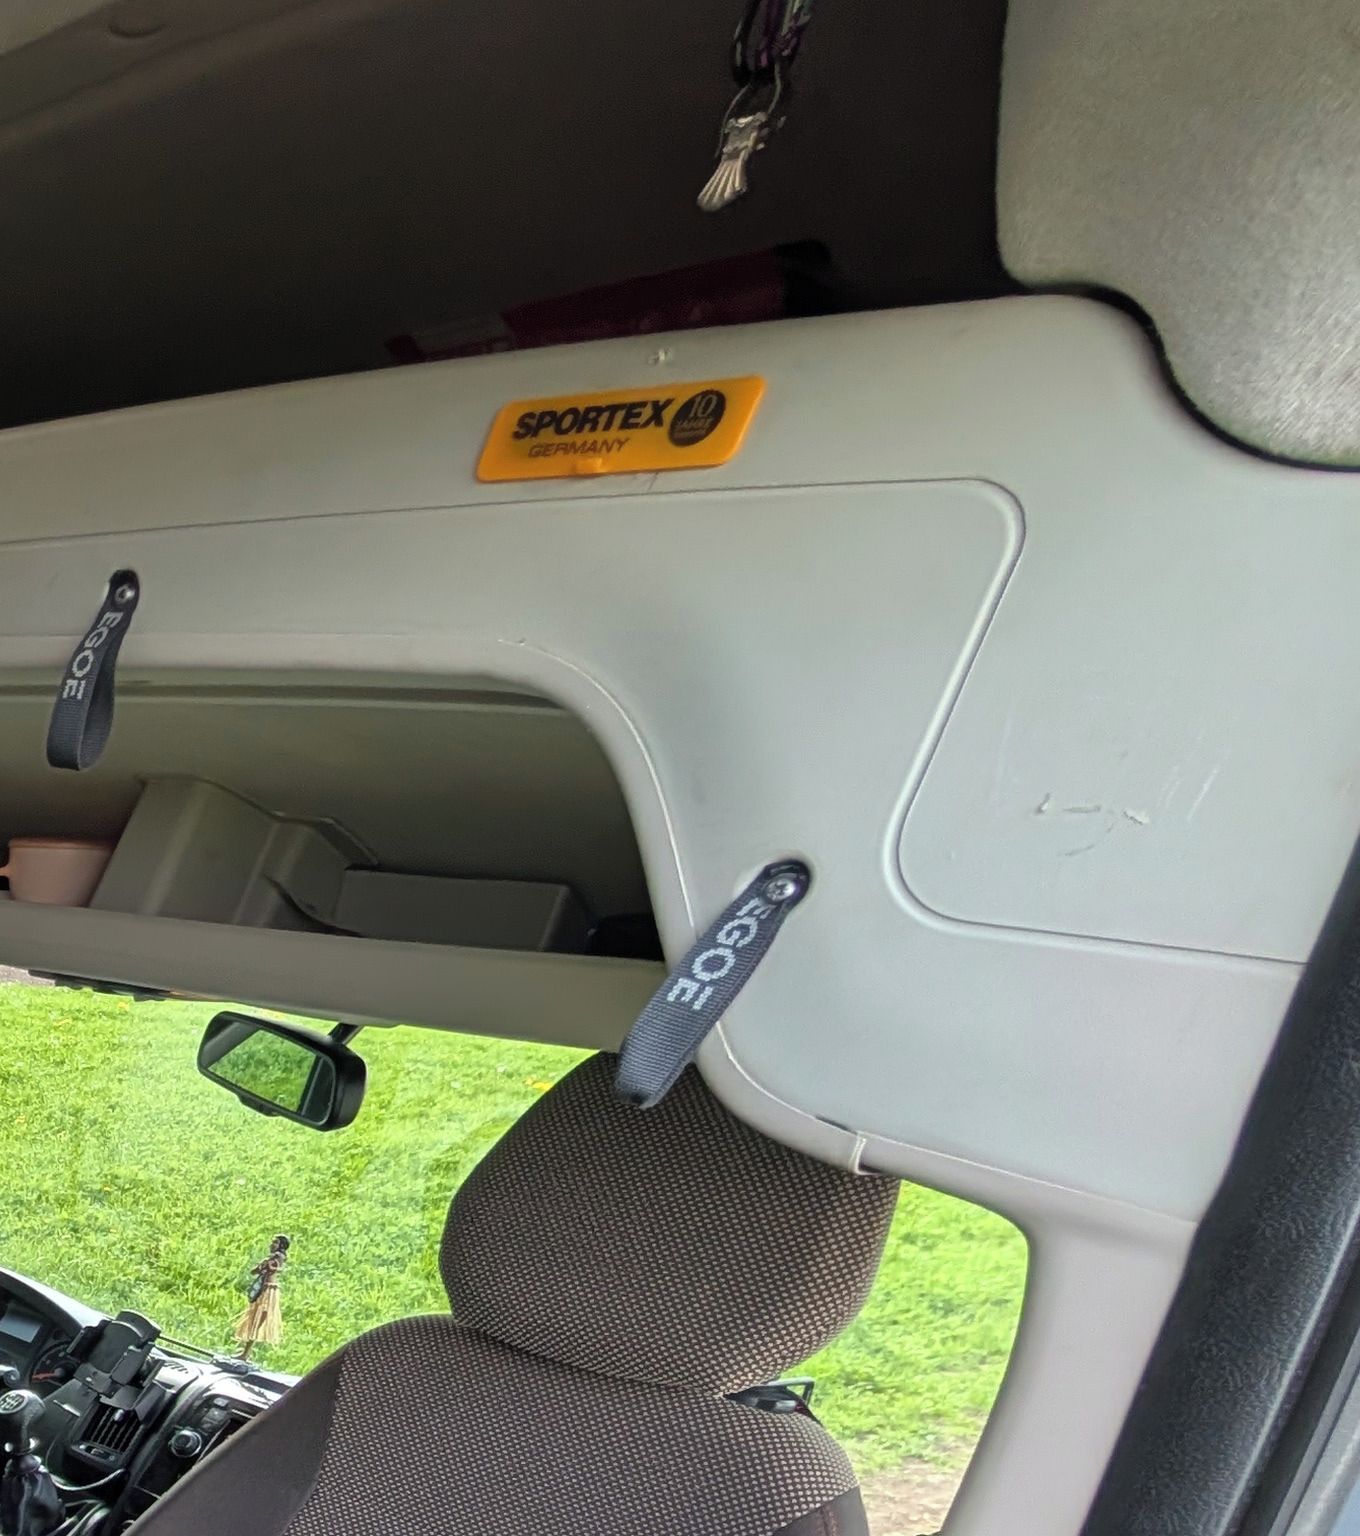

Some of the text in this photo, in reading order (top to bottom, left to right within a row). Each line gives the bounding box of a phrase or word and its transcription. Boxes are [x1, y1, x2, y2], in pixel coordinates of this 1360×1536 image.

[512, 397, 674, 440] SPORTEX
[689, 394, 718, 418] 10
[528, 438, 630, 458] GERMANY
[62, 612, 124, 699] EGOE
[666, 897, 773, 1010] EGOE
